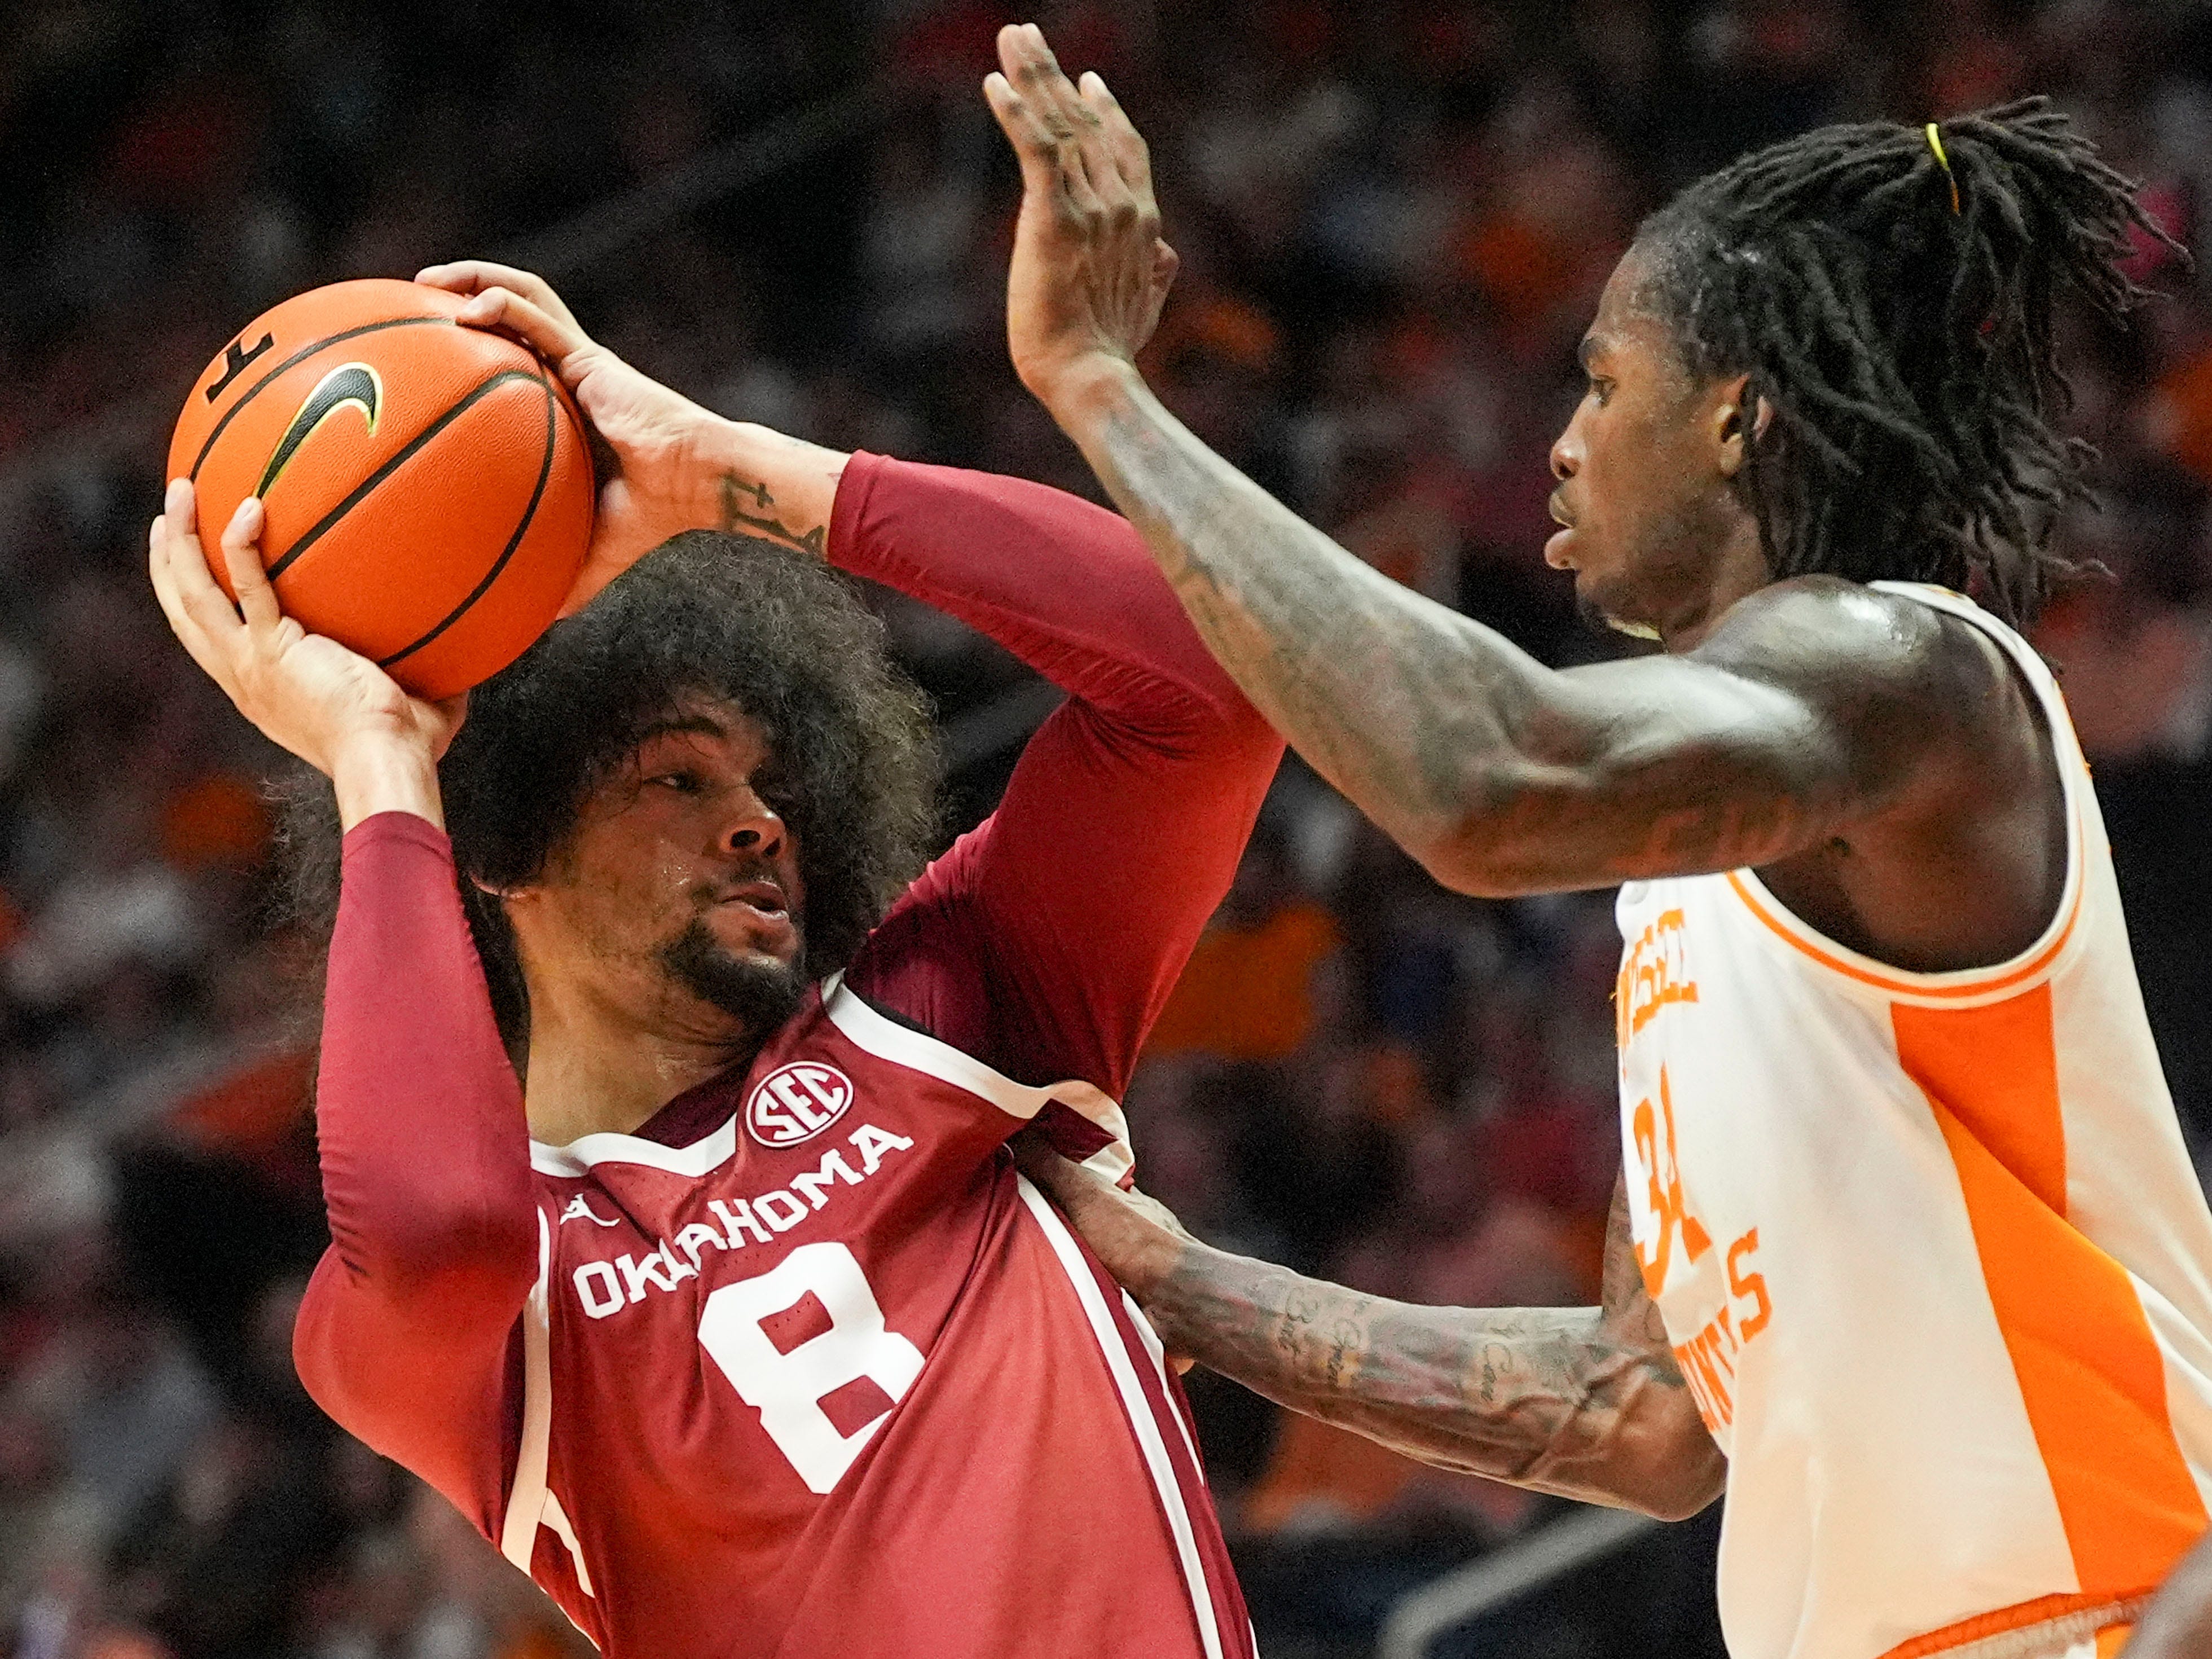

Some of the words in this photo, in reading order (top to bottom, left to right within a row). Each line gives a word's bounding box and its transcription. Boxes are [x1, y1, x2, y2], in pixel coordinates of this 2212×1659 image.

[755, 1068, 845, 1140] SEC
[573, 1123, 914, 1320] OKLAHOMA
[697, 1241, 927, 1495] 8
